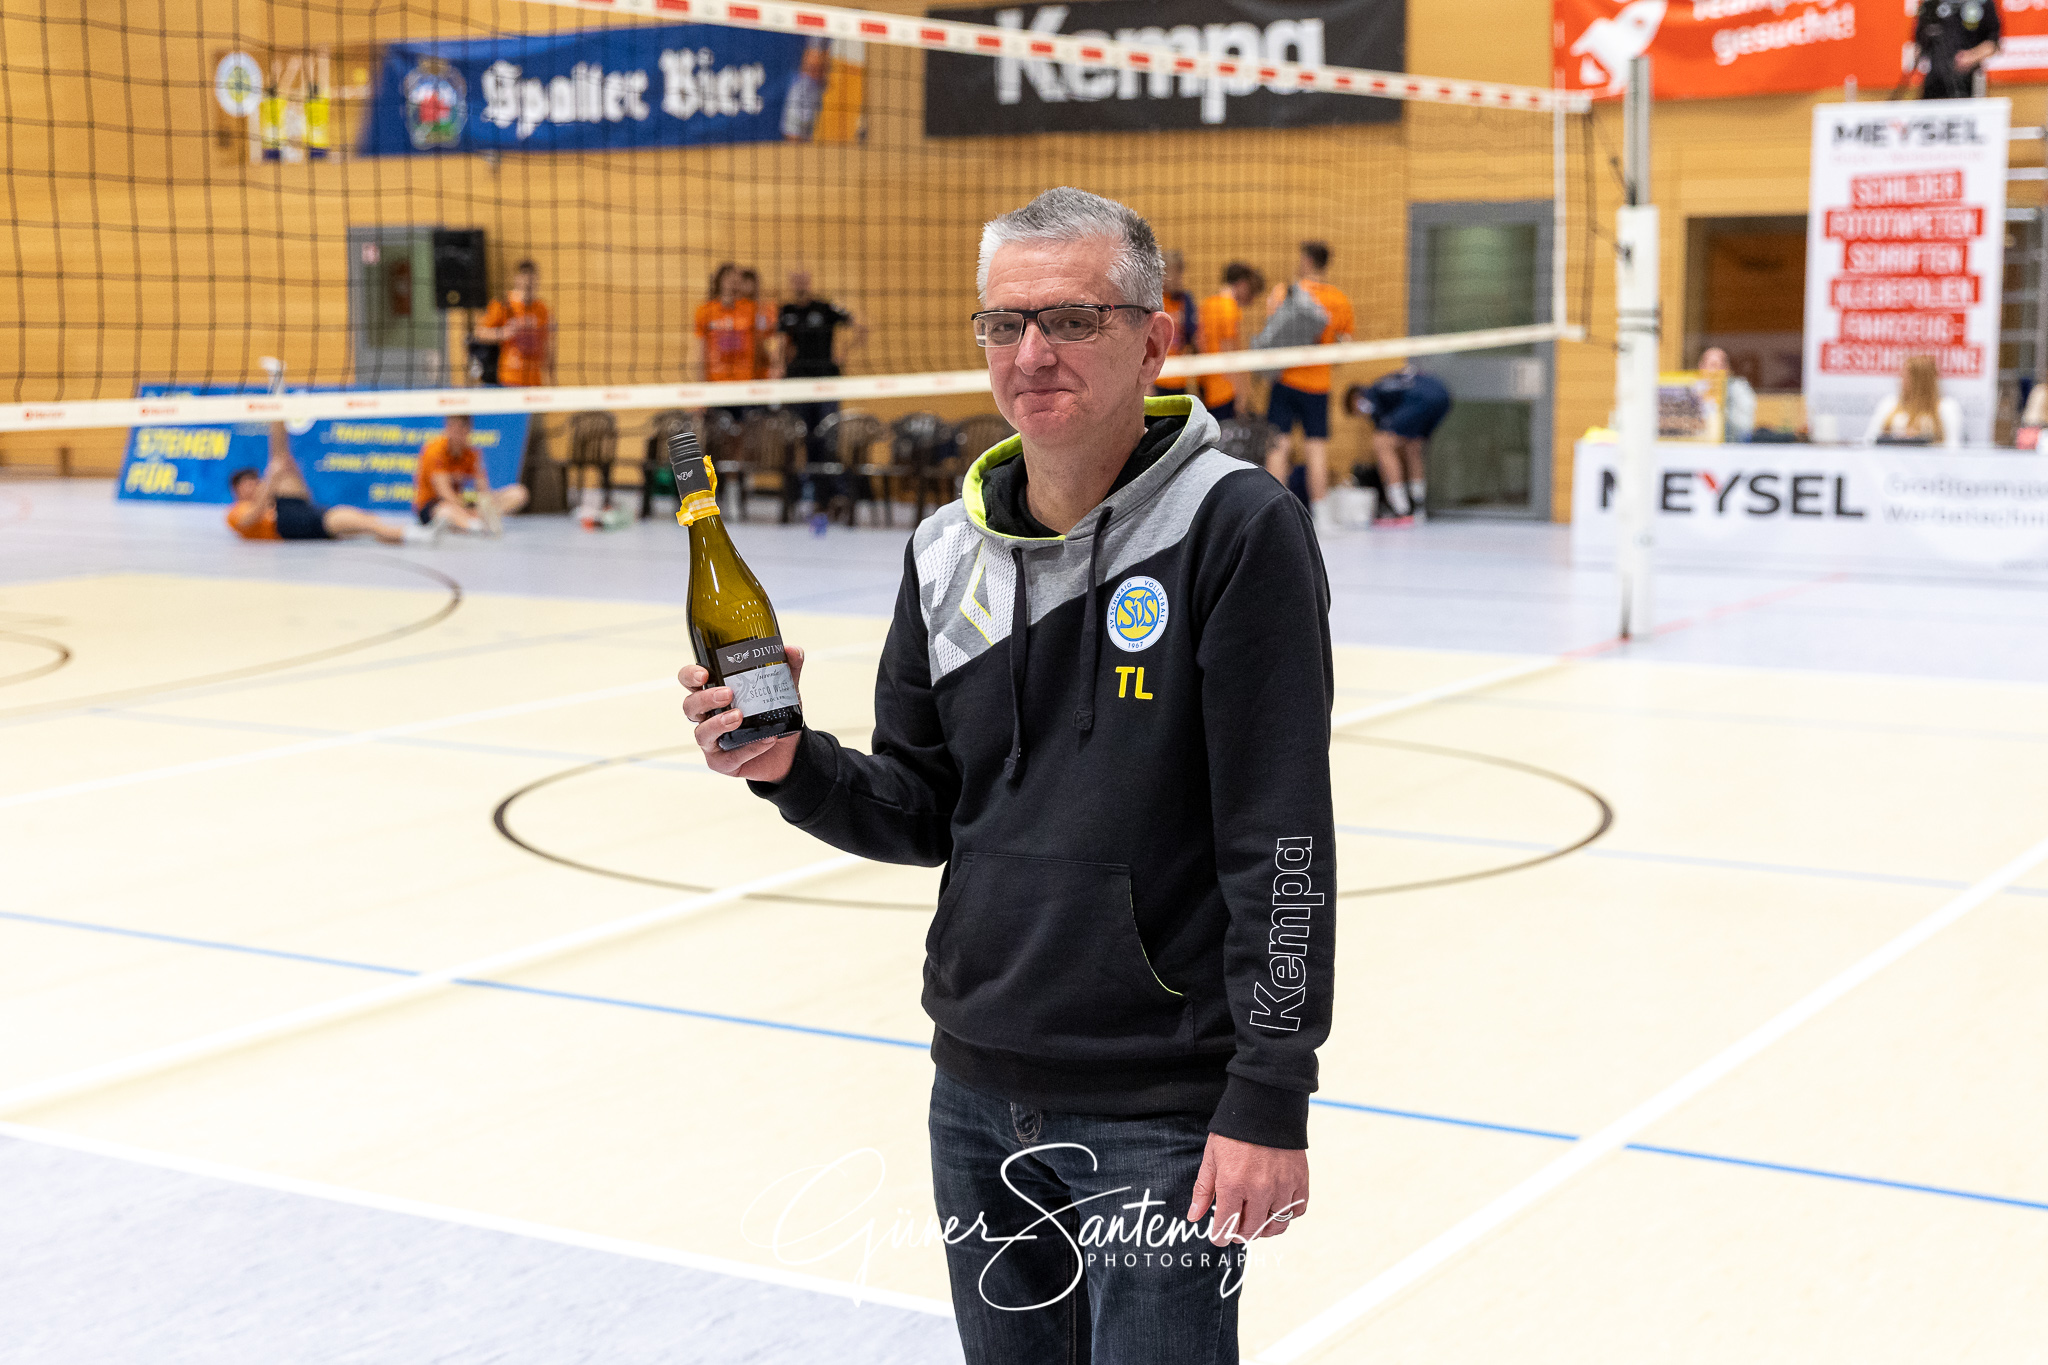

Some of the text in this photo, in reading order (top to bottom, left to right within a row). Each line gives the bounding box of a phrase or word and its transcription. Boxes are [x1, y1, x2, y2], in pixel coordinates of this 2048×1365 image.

[659, 47, 766, 120] Bier
[994, 3, 1324, 123] Kempa
[1833, 119, 1986, 146] MEYSEL
[1110, 581, 1132, 616] SCHWAIG
[1144, 580, 1166, 624] VOLLEYBALL
[750, 682, 791, 699] SECCO WEISS
[1115, 666, 1153, 700] TL
[1250, 836, 1324, 1031] Kempa
